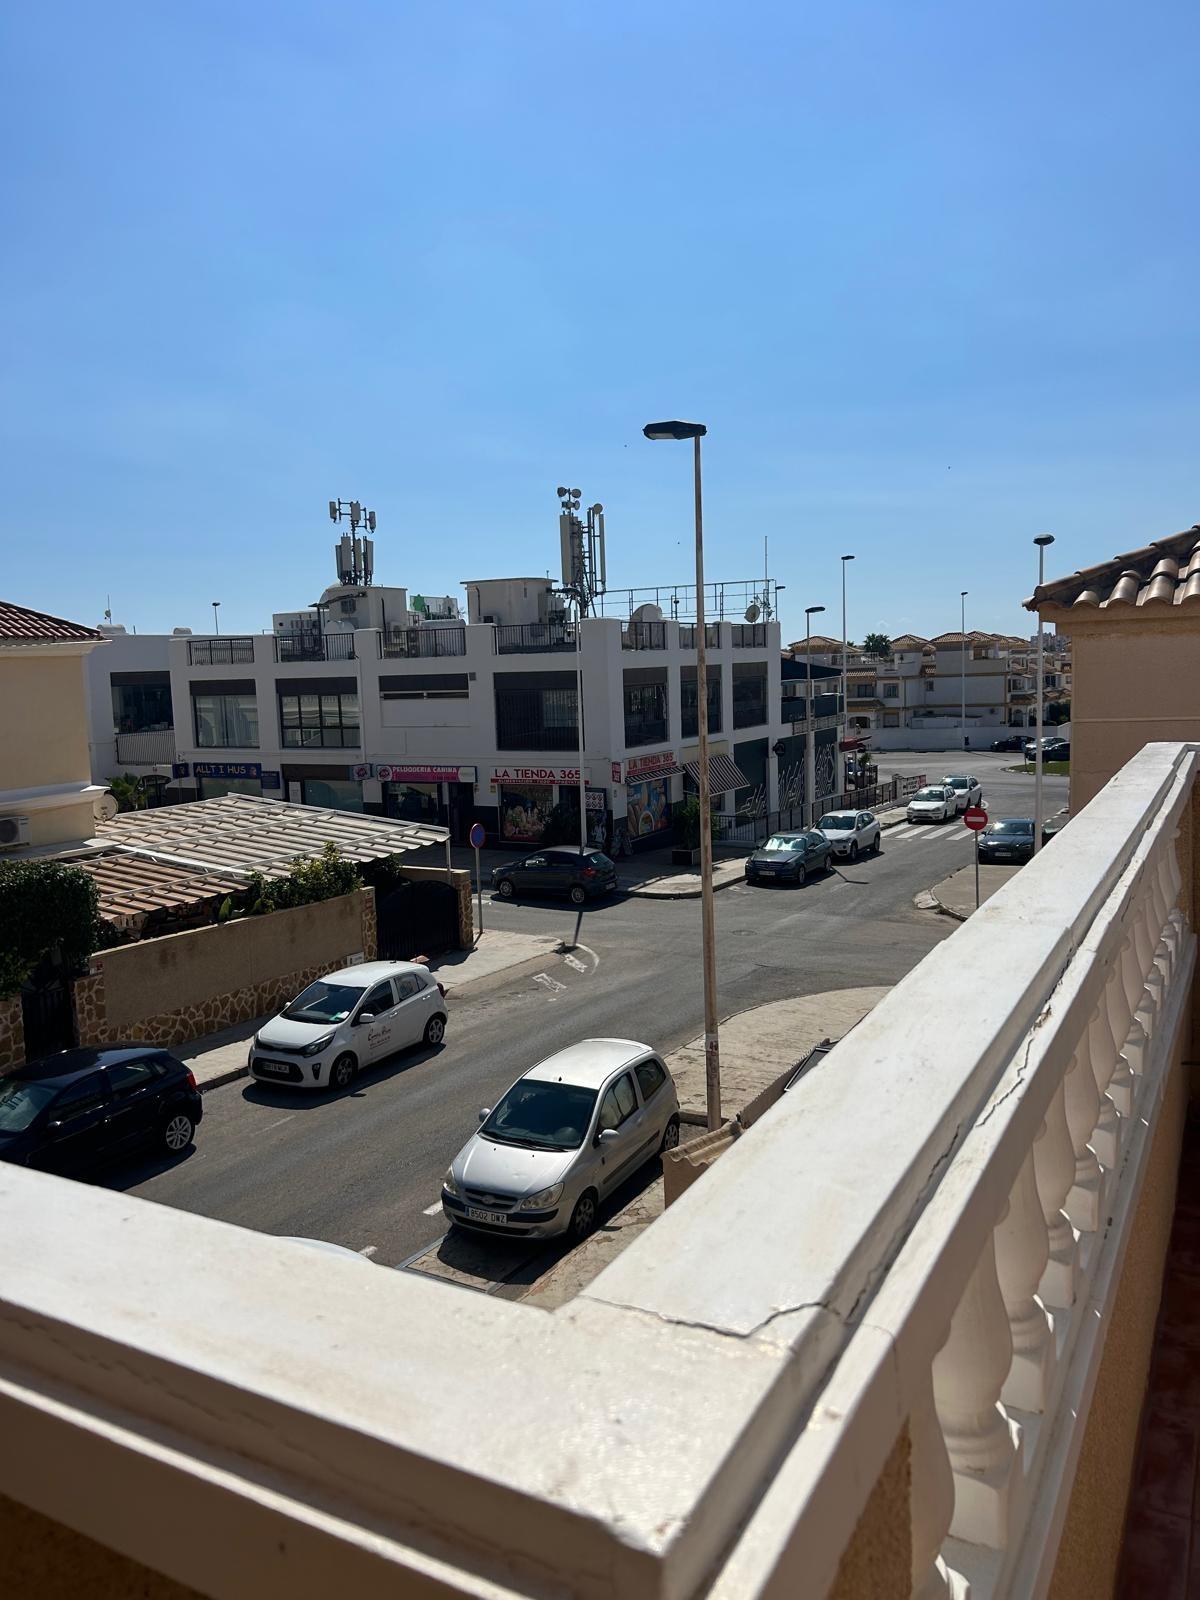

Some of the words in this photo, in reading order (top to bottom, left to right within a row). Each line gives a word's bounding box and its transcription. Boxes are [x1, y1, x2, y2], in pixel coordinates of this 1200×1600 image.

[196, 765, 215, 774] ALLT
[218, 765, 225, 774] I
[227, 764, 246, 774] HUS
[494, 768, 510, 778] LA
[513, 768, 556, 779] TIENDA
[560, 769, 581, 779] 365
[471, 1209, 487, 1220] 8502
